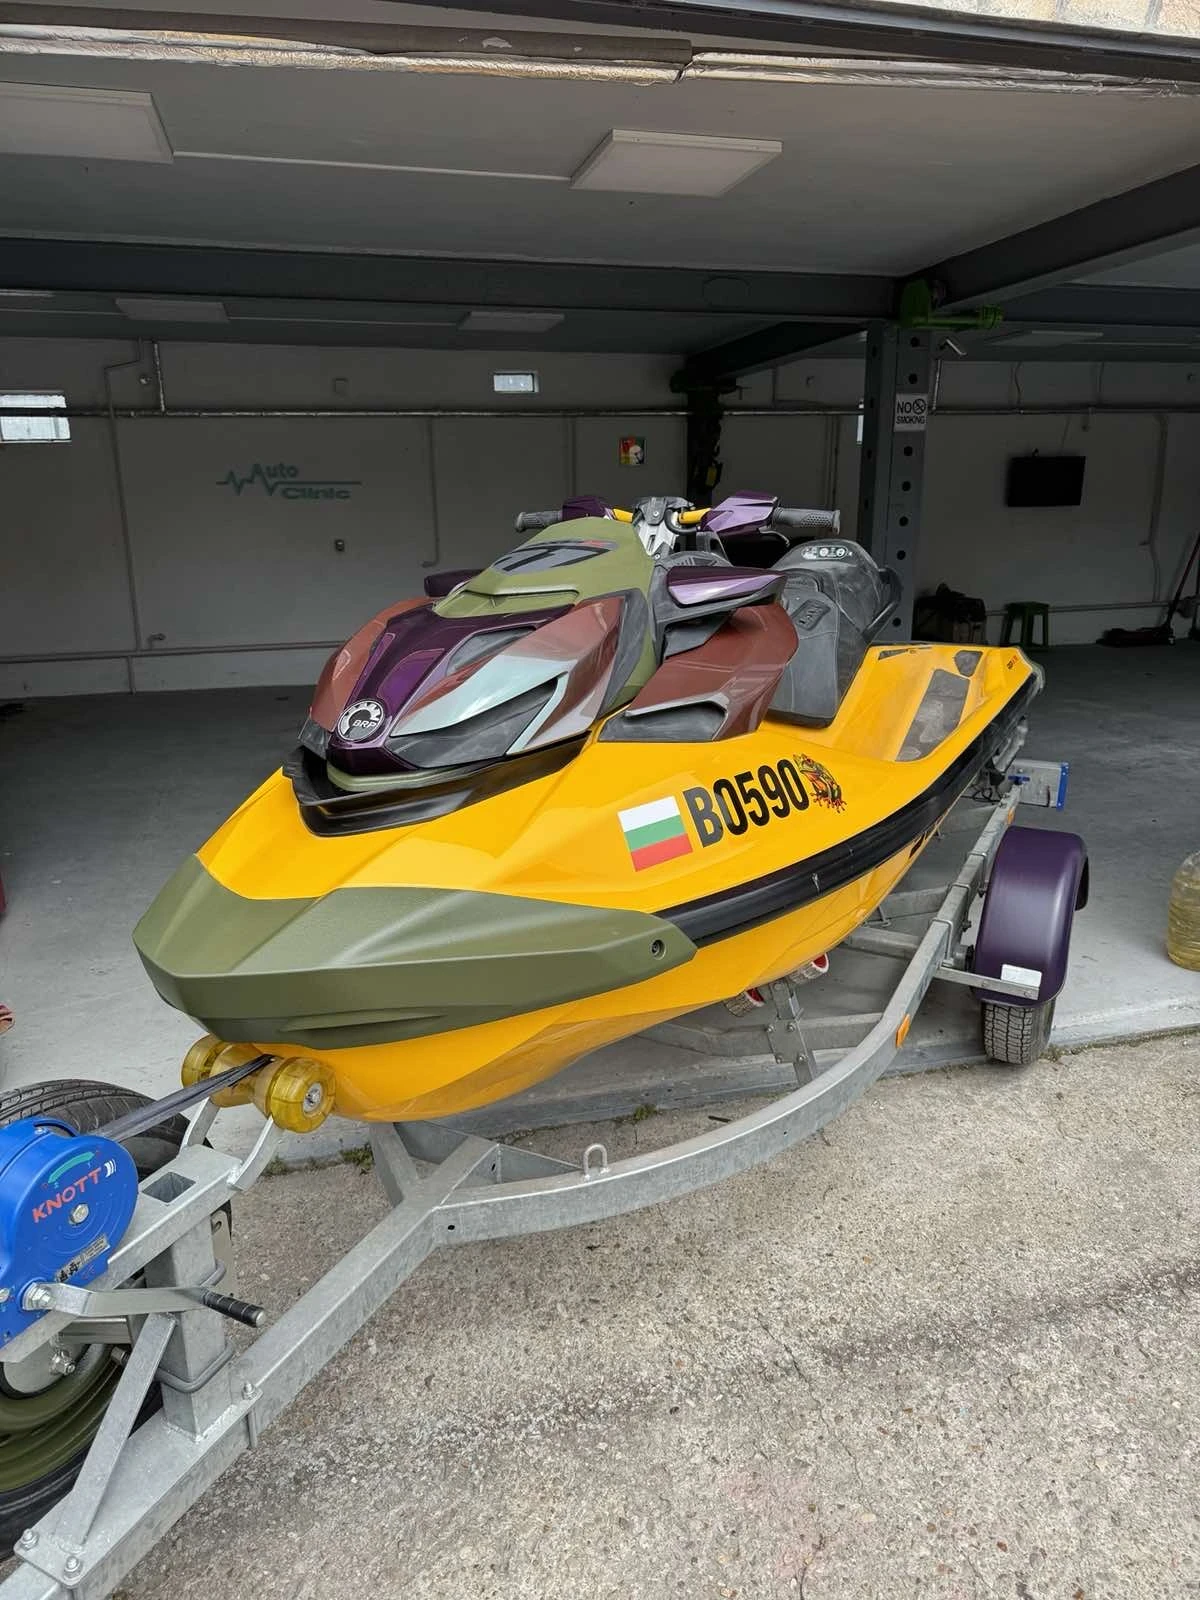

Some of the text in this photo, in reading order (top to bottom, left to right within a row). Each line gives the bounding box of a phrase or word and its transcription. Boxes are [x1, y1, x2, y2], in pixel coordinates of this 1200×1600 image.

[896, 400, 912, 414] NO
[895, 415, 927, 425] SMOKING
[252, 462, 299, 483] Auto
[281, 487, 352, 500] Clinic
[352, 719, 378, 729] BRP
[32, 1166, 103, 1224] KNOTT
